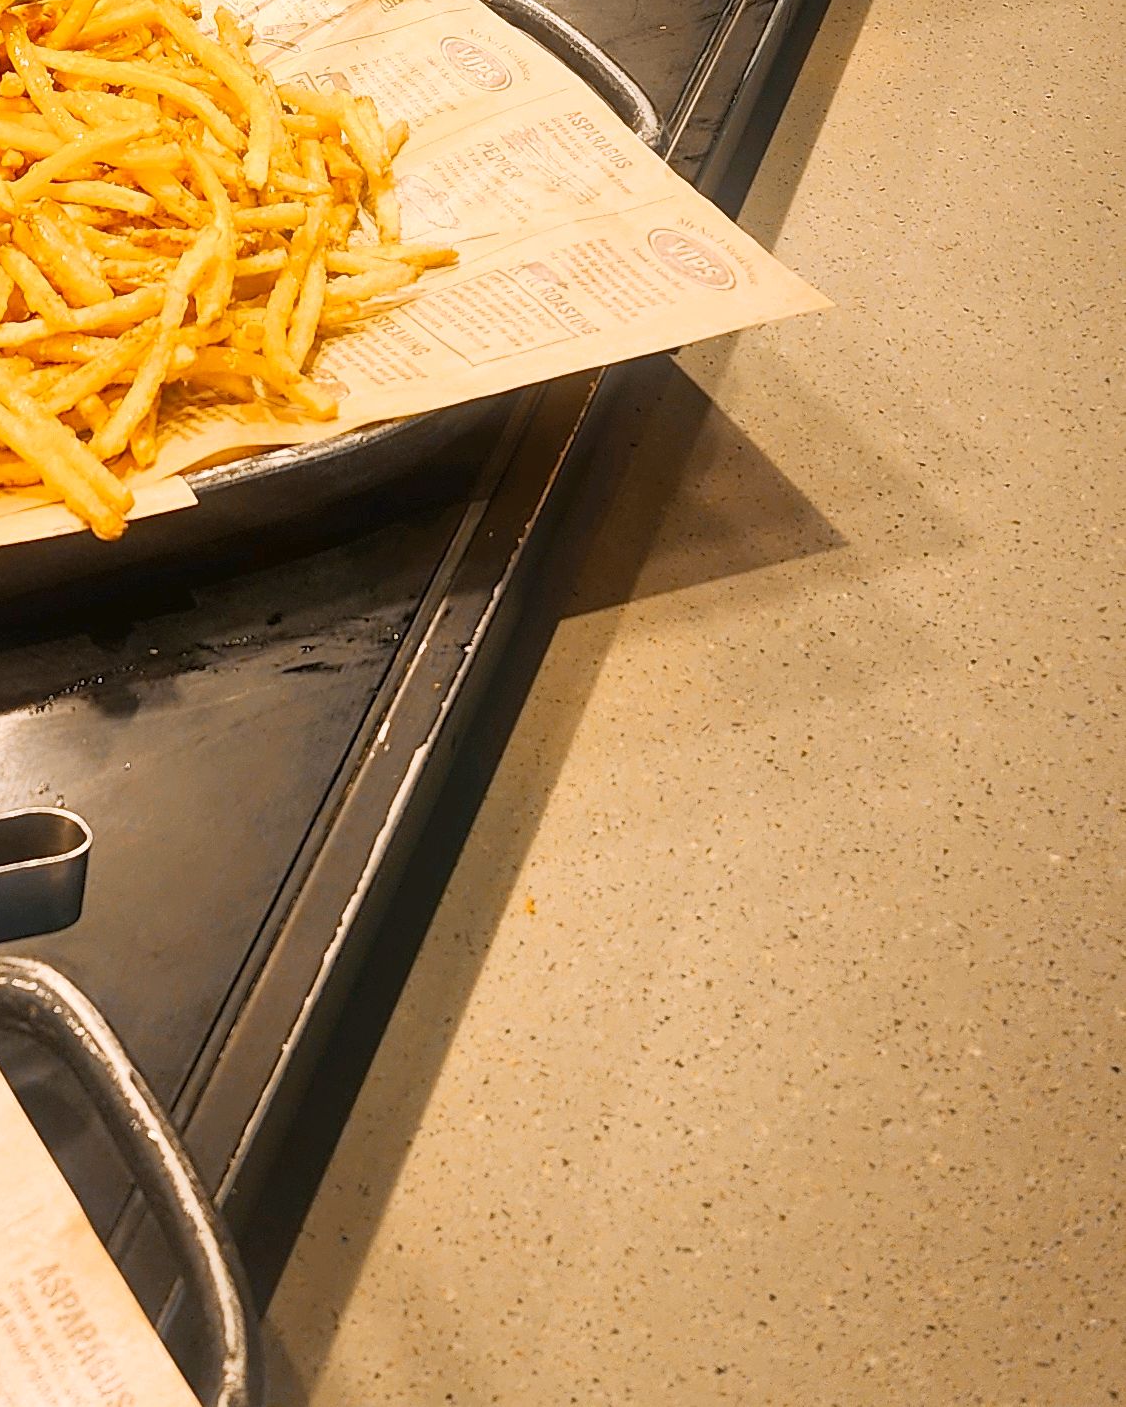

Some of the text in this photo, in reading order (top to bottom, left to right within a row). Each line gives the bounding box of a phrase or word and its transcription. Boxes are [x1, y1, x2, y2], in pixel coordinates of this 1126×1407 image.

[457, 46, 501, 83] VIPS
[477, 141, 524, 179] PEPPER
[564, 111, 633, 170] ASPARAGUS
[668, 238, 722, 278] VIPS
[540, 286, 601, 335] ROASTING
